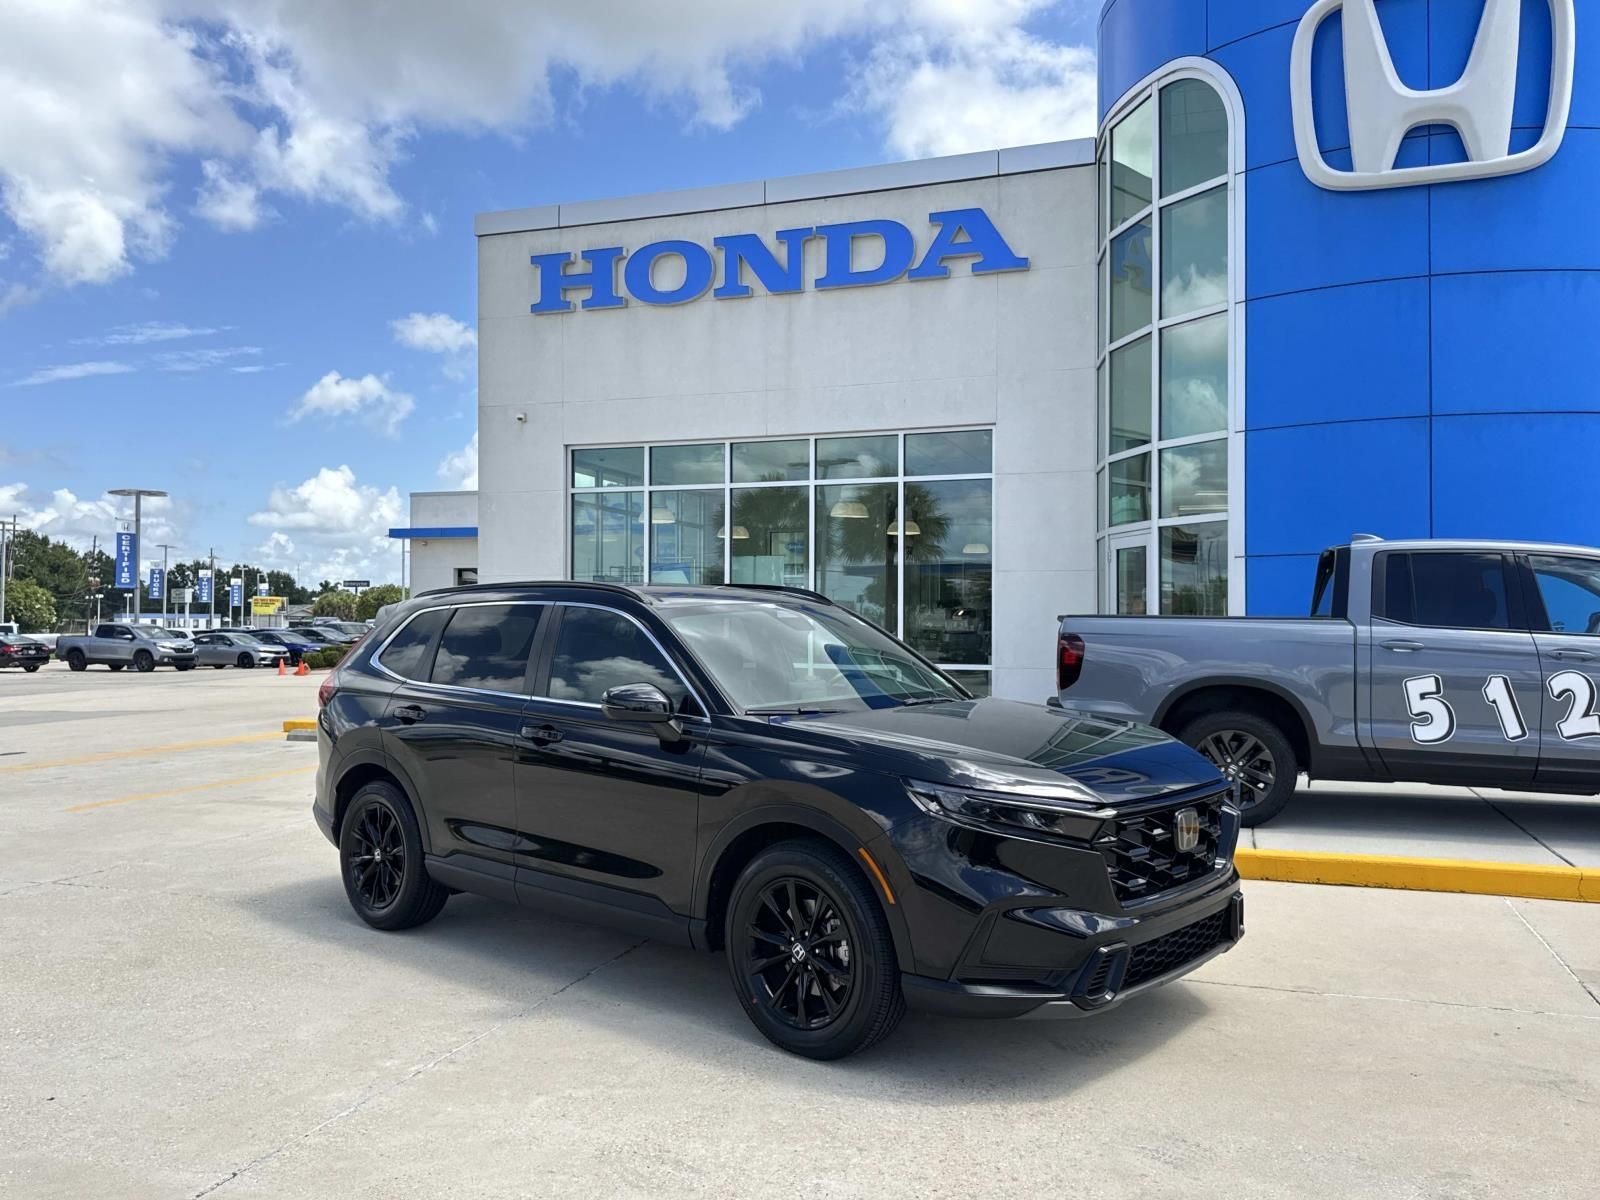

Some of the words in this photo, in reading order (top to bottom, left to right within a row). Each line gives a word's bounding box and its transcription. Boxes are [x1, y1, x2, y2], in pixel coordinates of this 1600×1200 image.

[530, 208, 1030, 315] HONDA
[121, 534, 131, 584] CERTIFIED
[152, 569, 160, 596] TRUCKS
[201, 577, 209, 601] TRUCKS
